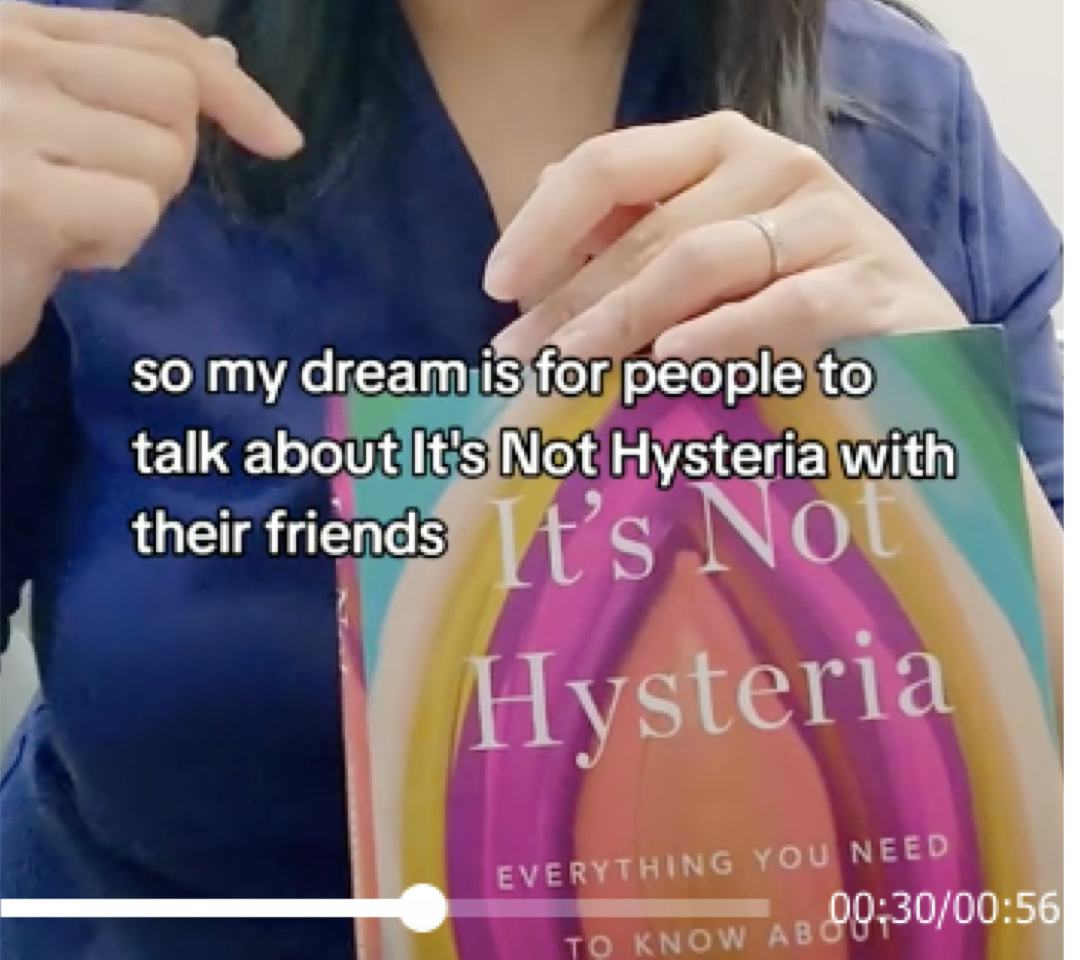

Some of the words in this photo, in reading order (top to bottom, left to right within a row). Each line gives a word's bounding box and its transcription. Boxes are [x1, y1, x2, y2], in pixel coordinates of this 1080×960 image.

[488, 489, 656, 590] It's
[686, 478, 901, 575] Not
[465, 630, 955, 770] Hysteria
[498, 850, 733, 890] EVERYTHING
[755, 843, 830, 869] YOU
[851, 834, 950, 864] NEED
[566, 936, 613, 960] TO
[634, 927, 747, 958] KNOW
[768, 913, 893, 948] ABOUT
